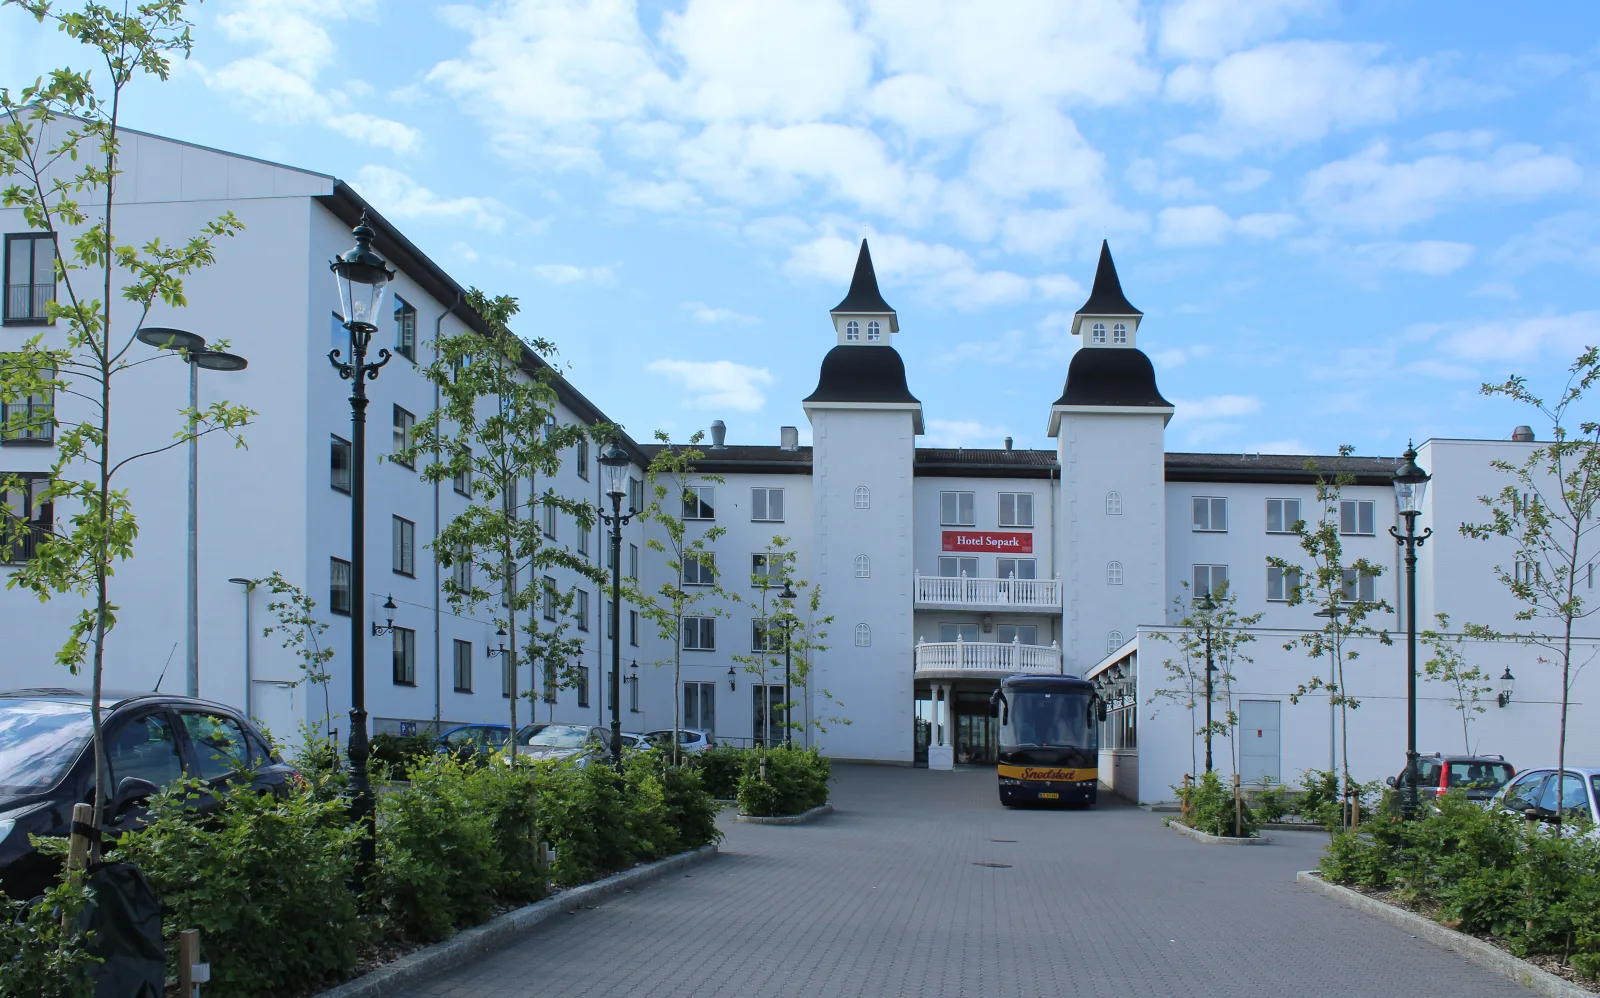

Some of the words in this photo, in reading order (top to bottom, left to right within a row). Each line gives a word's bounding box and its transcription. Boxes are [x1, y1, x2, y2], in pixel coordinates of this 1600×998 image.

[957, 535, 983, 546] Hotel
[985, 536, 1019, 548] Søpark
[1021, 767, 1076, 780] Snedsted
